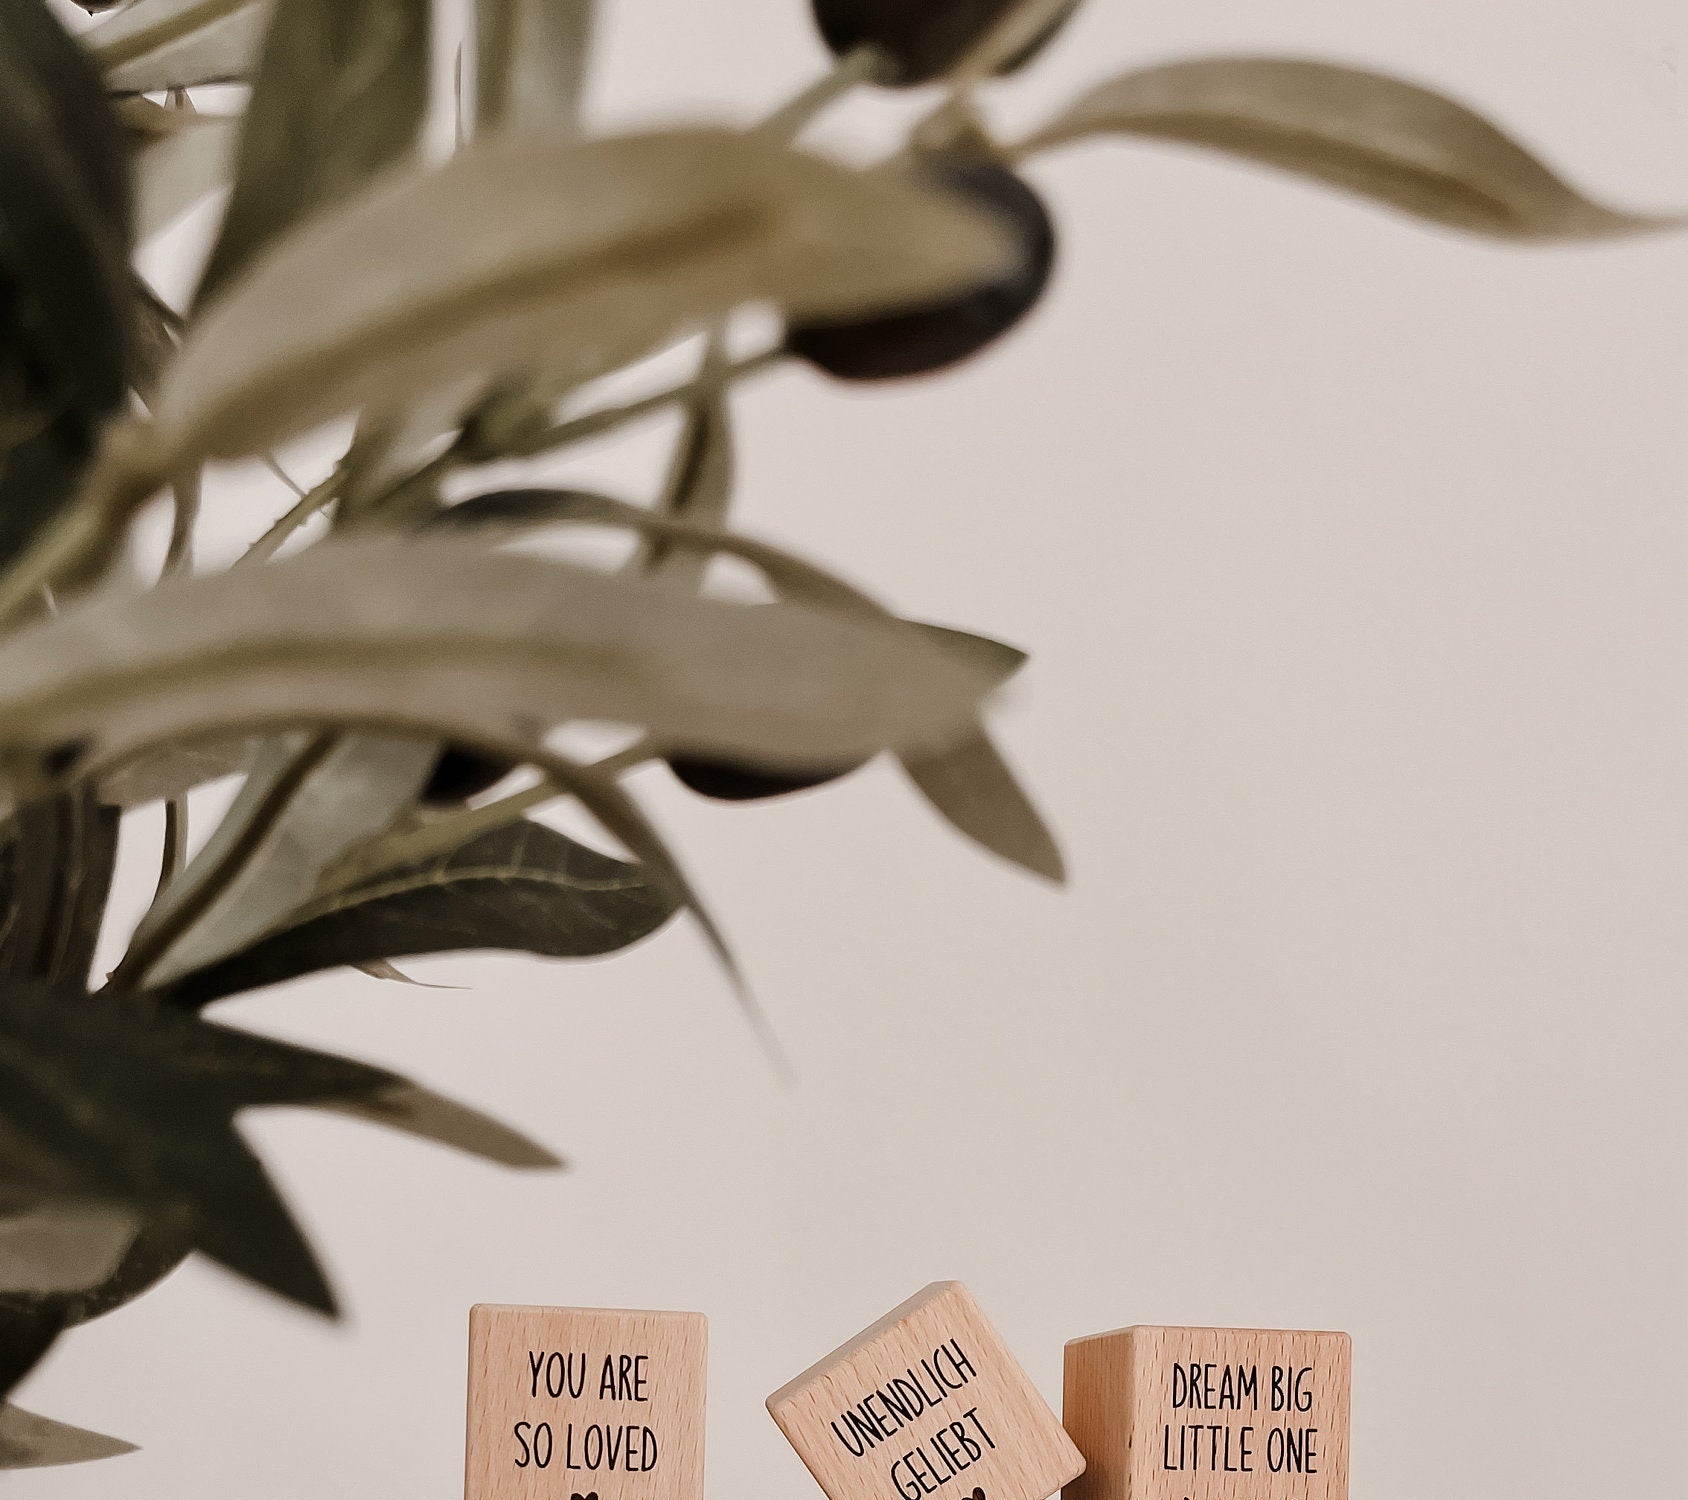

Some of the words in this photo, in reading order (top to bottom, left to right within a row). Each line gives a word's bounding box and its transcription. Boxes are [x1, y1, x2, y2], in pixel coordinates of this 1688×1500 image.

[528, 1350, 586, 1399] YOU
[599, 1354, 649, 1402] ARE
[830, 1338, 978, 1459] UNENDLICH
[1172, 1362, 1258, 1411] DREAM
[1271, 1365, 1313, 1412] BIG
[513, 1421, 553, 1469] SO
[566, 1423, 658, 1473] LOVED
[1163, 1424, 1254, 1472] LITTLE
[1266, 1427, 1318, 1474] ONE
